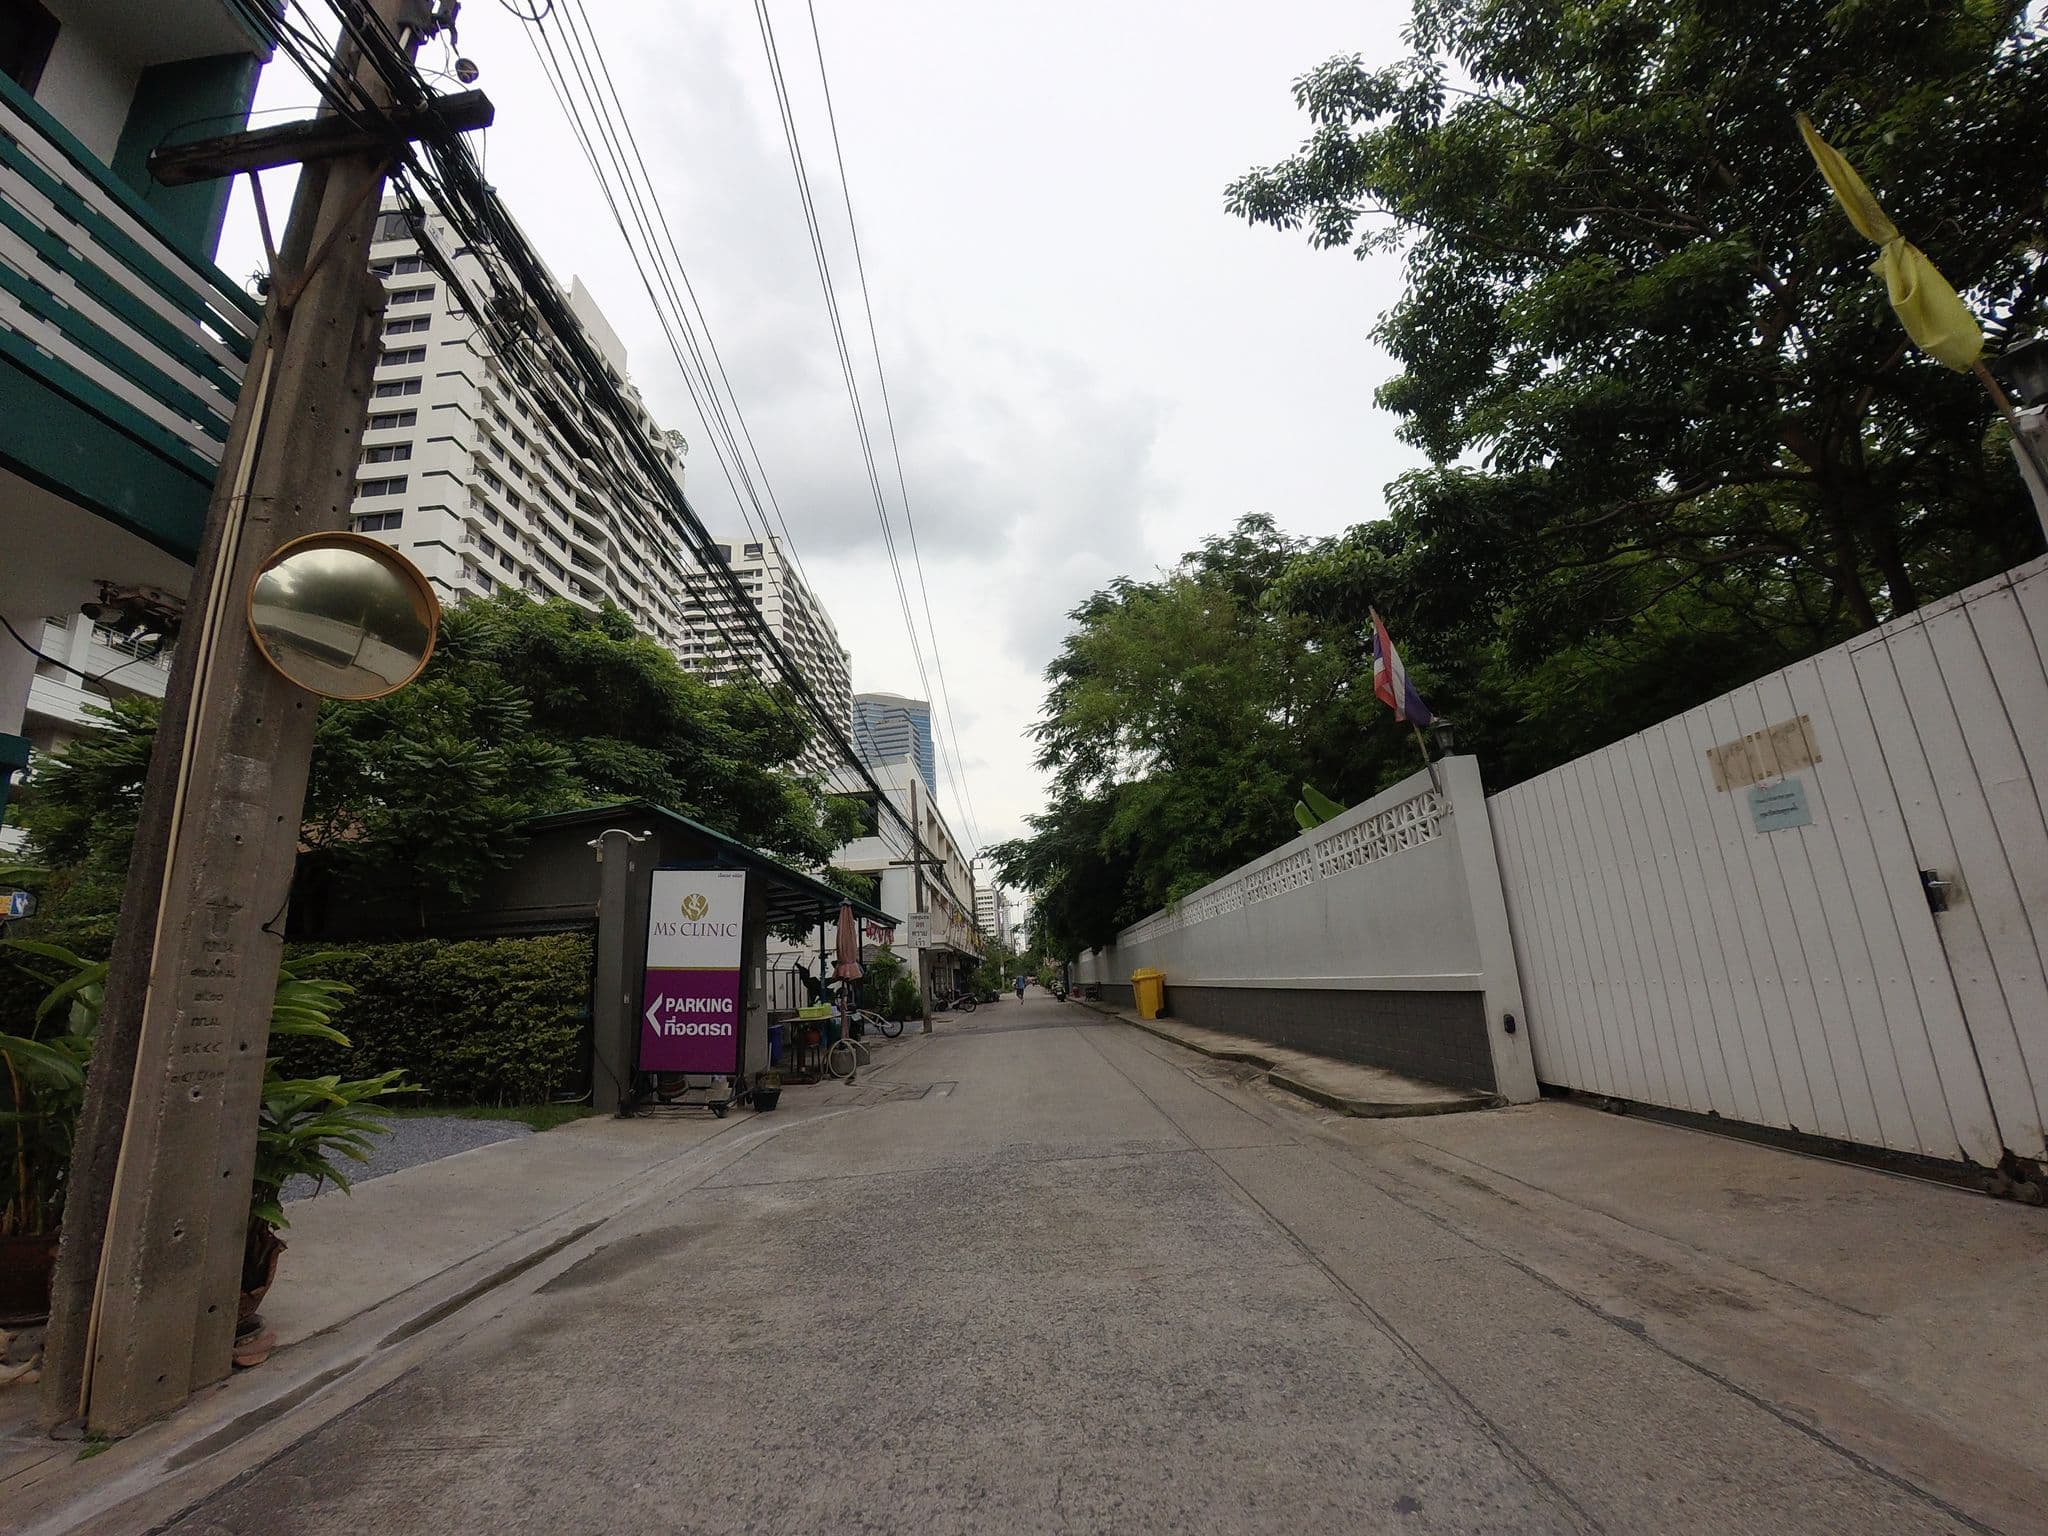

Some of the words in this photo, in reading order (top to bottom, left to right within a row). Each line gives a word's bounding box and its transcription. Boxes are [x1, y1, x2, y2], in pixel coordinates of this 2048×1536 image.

[654, 922, 677, 936] MS
[680, 922, 737, 937] CLINIC
[665, 997, 733, 1013] PARKING
[664, 1016, 732, 1036] ที่จอดรถ
